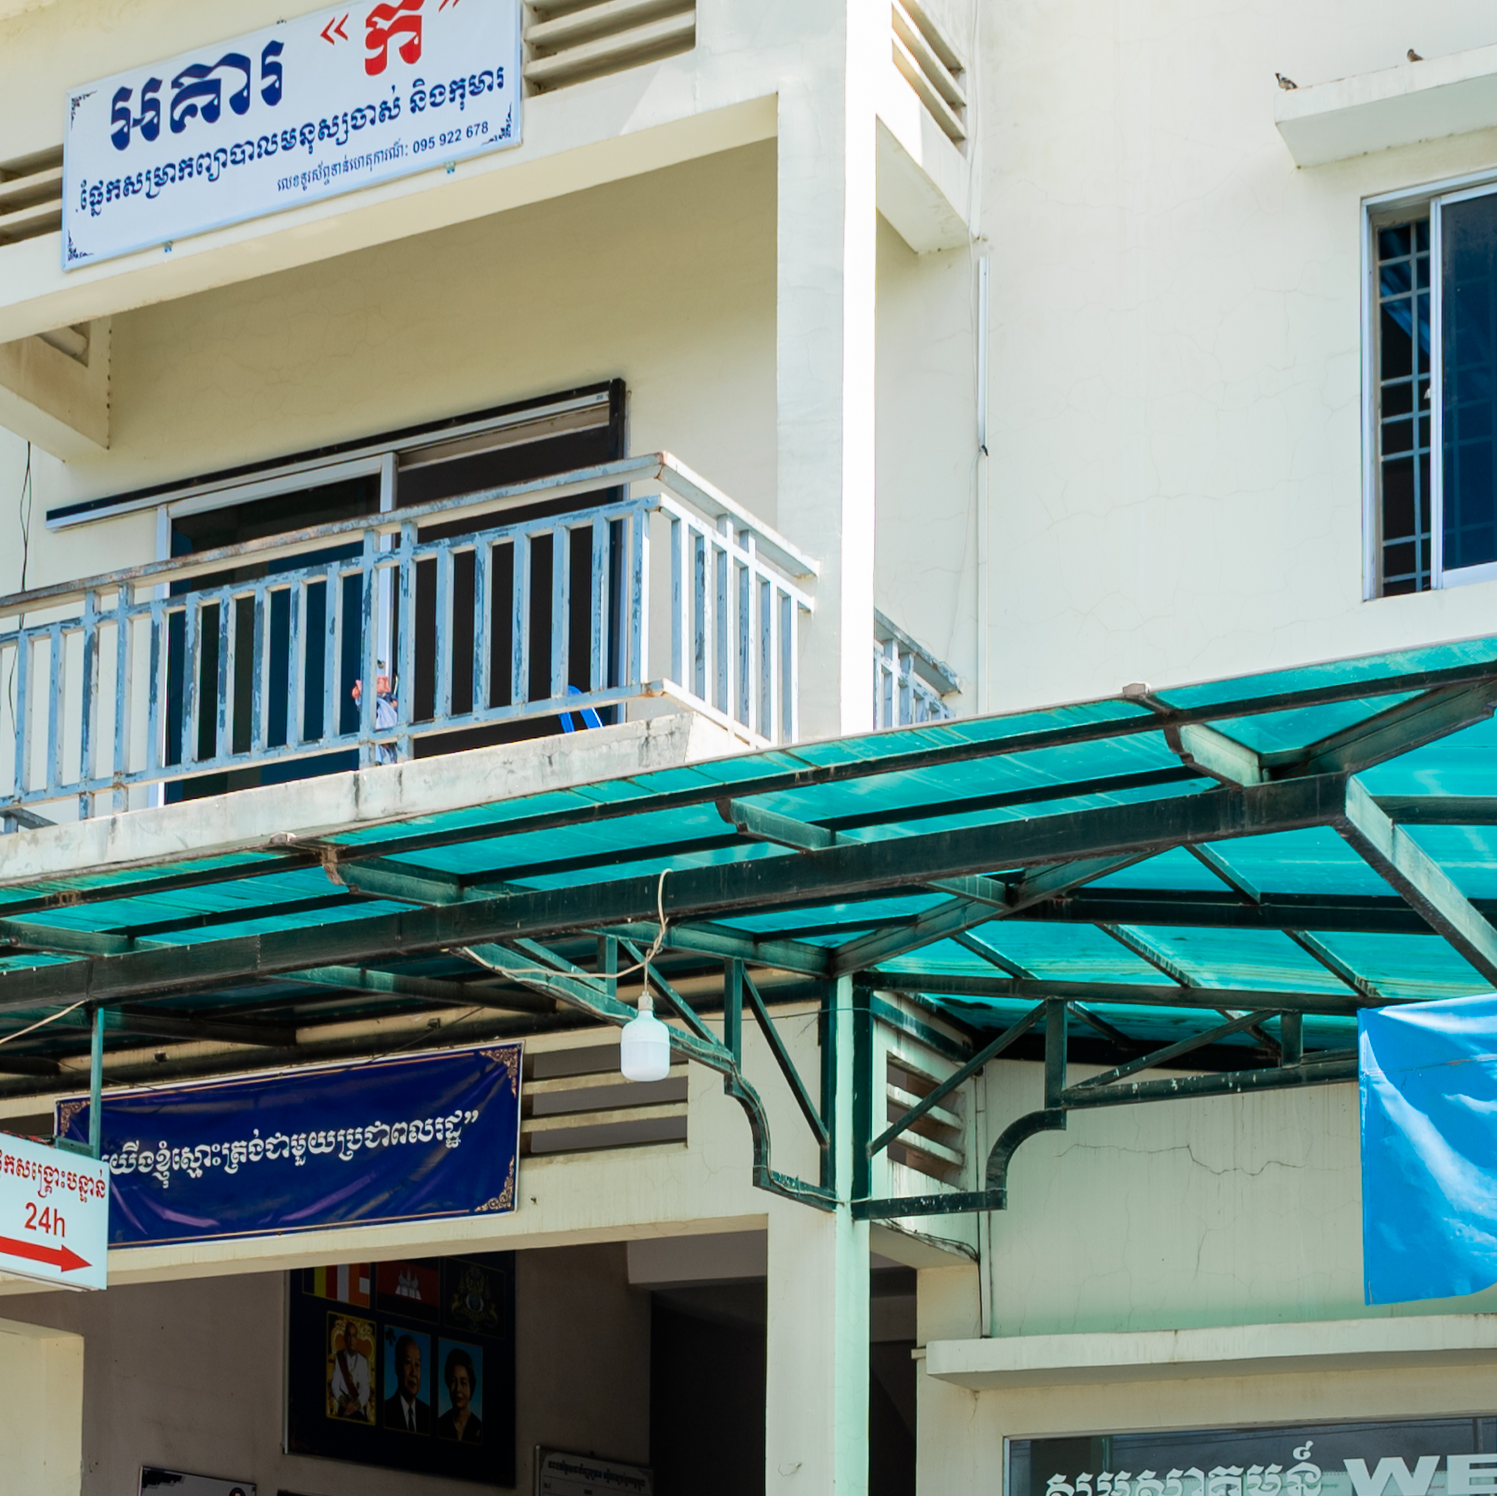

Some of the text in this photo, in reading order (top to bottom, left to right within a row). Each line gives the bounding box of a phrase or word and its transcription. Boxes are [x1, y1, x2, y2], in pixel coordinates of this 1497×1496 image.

[111, 40, 285, 151] អគារ
[409, 67, 505, 114] និងកុមារ
[412, 136, 436, 154] 095
[439, 129, 463, 149] 922
[466, 121, 489, 139] 678
[24, 1202, 66, 1238] 24h
